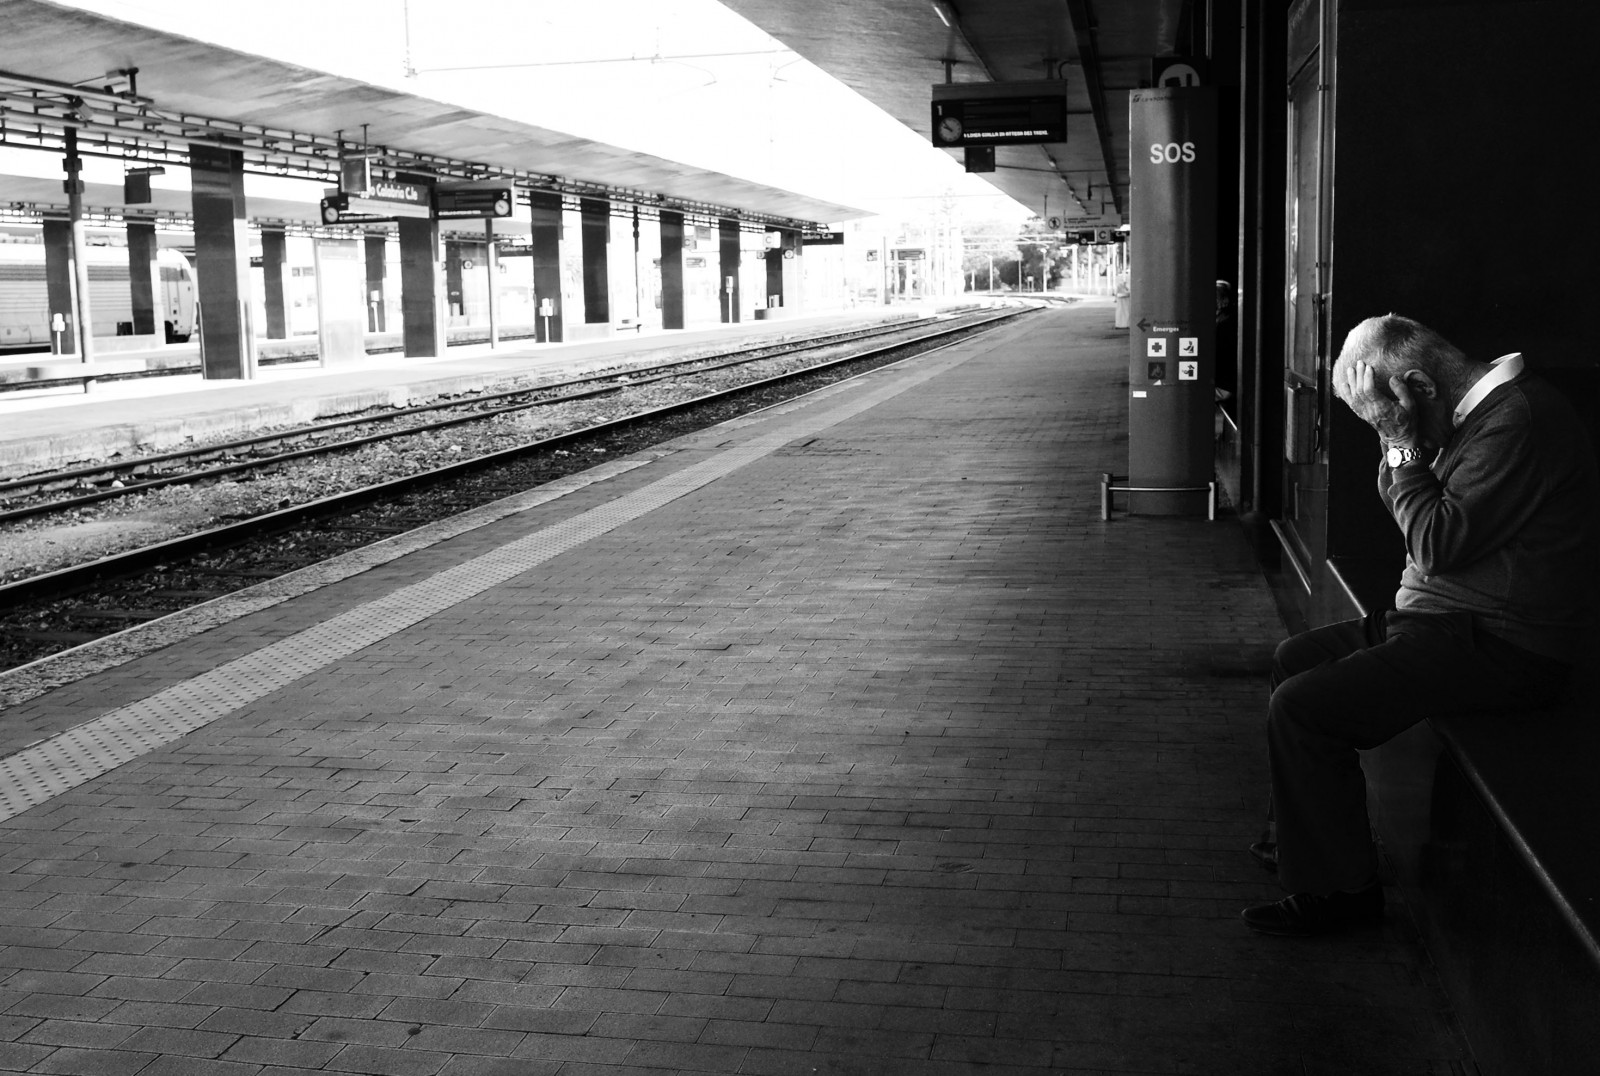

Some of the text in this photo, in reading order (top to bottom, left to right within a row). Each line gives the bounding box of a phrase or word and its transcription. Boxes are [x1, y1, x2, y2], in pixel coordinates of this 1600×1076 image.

[937, 105, 943, 116] 1
[1150, 141, 1196, 164] SOS
[376, 183, 405, 199] Calabria
[502, 191, 508, 199] 2
[323, 199, 329, 207] 3
[1099, 231, 1107, 239] C
[765, 236, 772, 244] C
